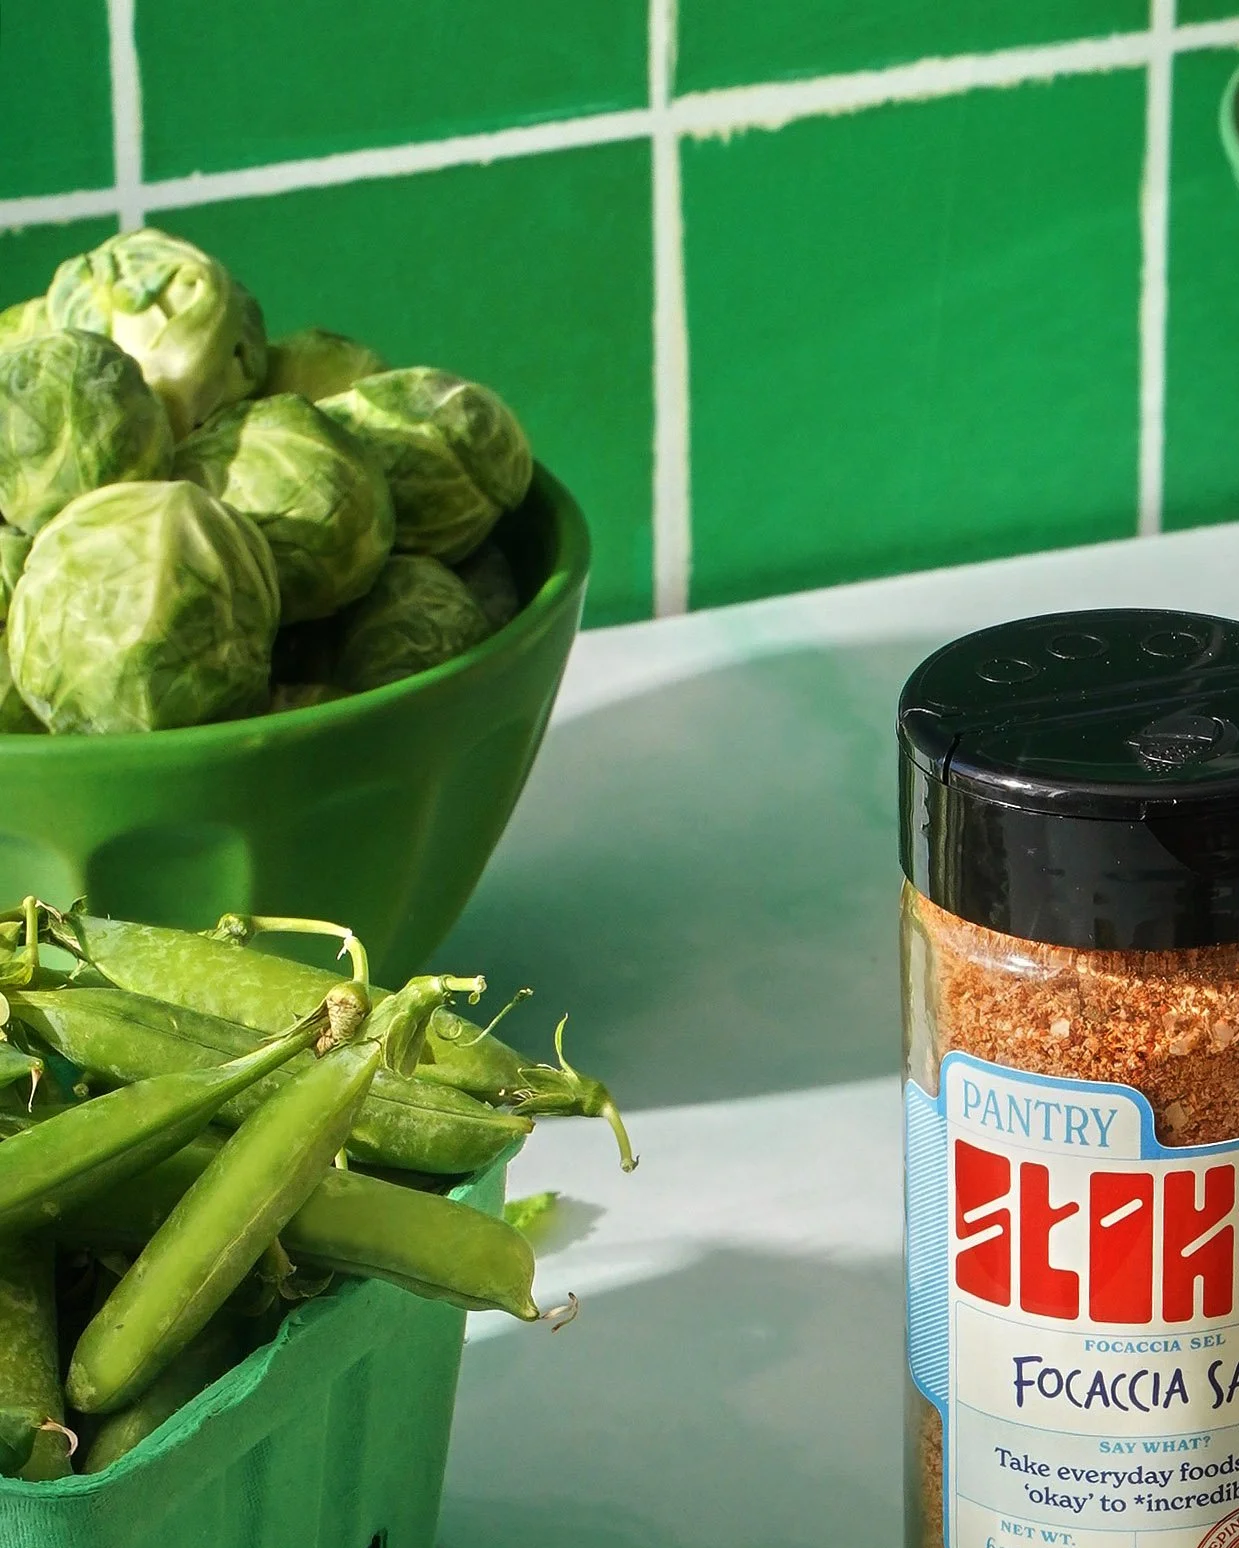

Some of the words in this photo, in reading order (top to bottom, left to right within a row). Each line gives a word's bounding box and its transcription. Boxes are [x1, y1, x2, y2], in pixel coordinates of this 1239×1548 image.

[962, 1079, 1118, 1148] PANTRY
[1084, 1338, 1182, 1354] FOCACCIA
[1190, 1333, 1226, 1350] SEL
[1012, 1355, 1189, 1413] FOCACCIA
[1100, 1439, 1136, 1455] SAY
[1142, 1435, 1211, 1453] WHAT?
[994, 1447, 1050, 1478] Take
[1057, 1462, 1173, 1488] everyday
[1100, 1493, 1127, 1513] to
[1000, 1520, 1037, 1540] NET
[1041, 1528, 1076, 1546] WT.
